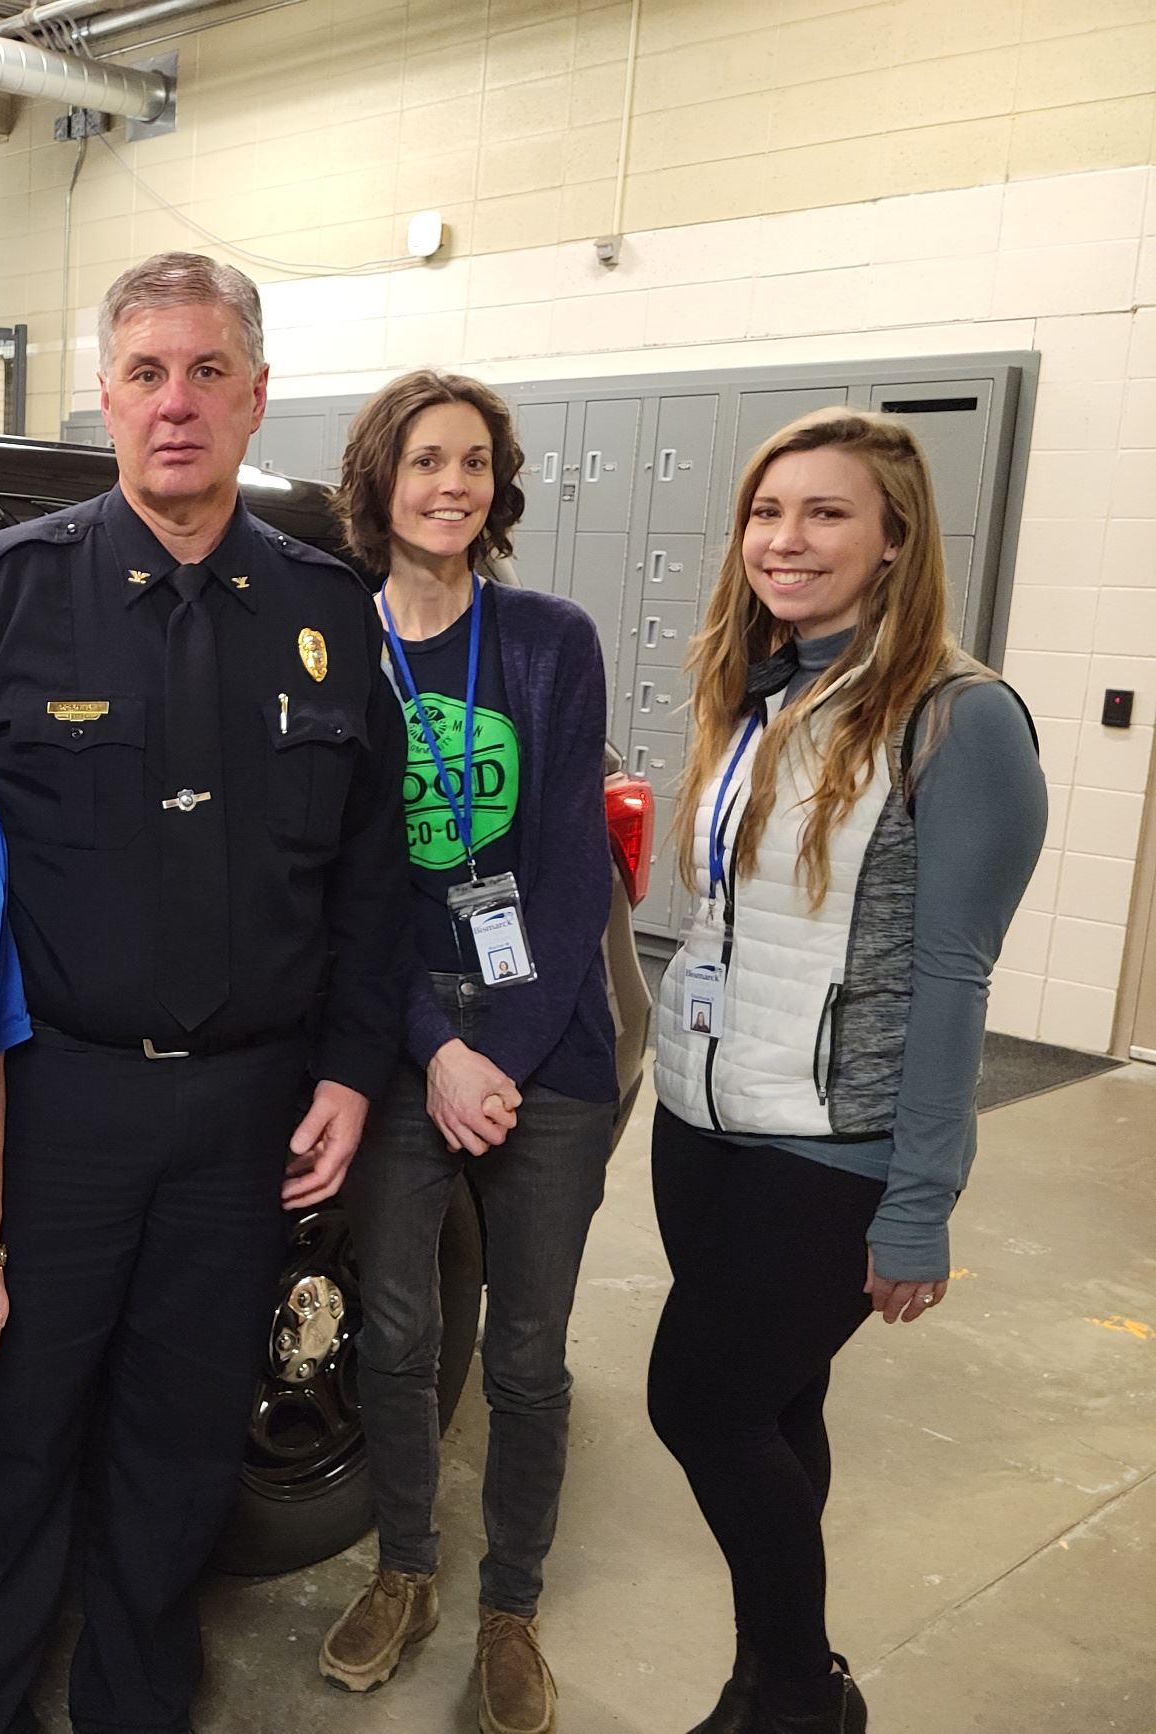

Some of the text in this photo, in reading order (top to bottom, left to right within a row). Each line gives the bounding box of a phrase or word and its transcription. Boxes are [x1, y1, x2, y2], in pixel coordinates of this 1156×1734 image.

[452, 720, 484, 739] MN
[403, 759, 506, 805] OOD
[405, 817, 473, 847] CO-O
